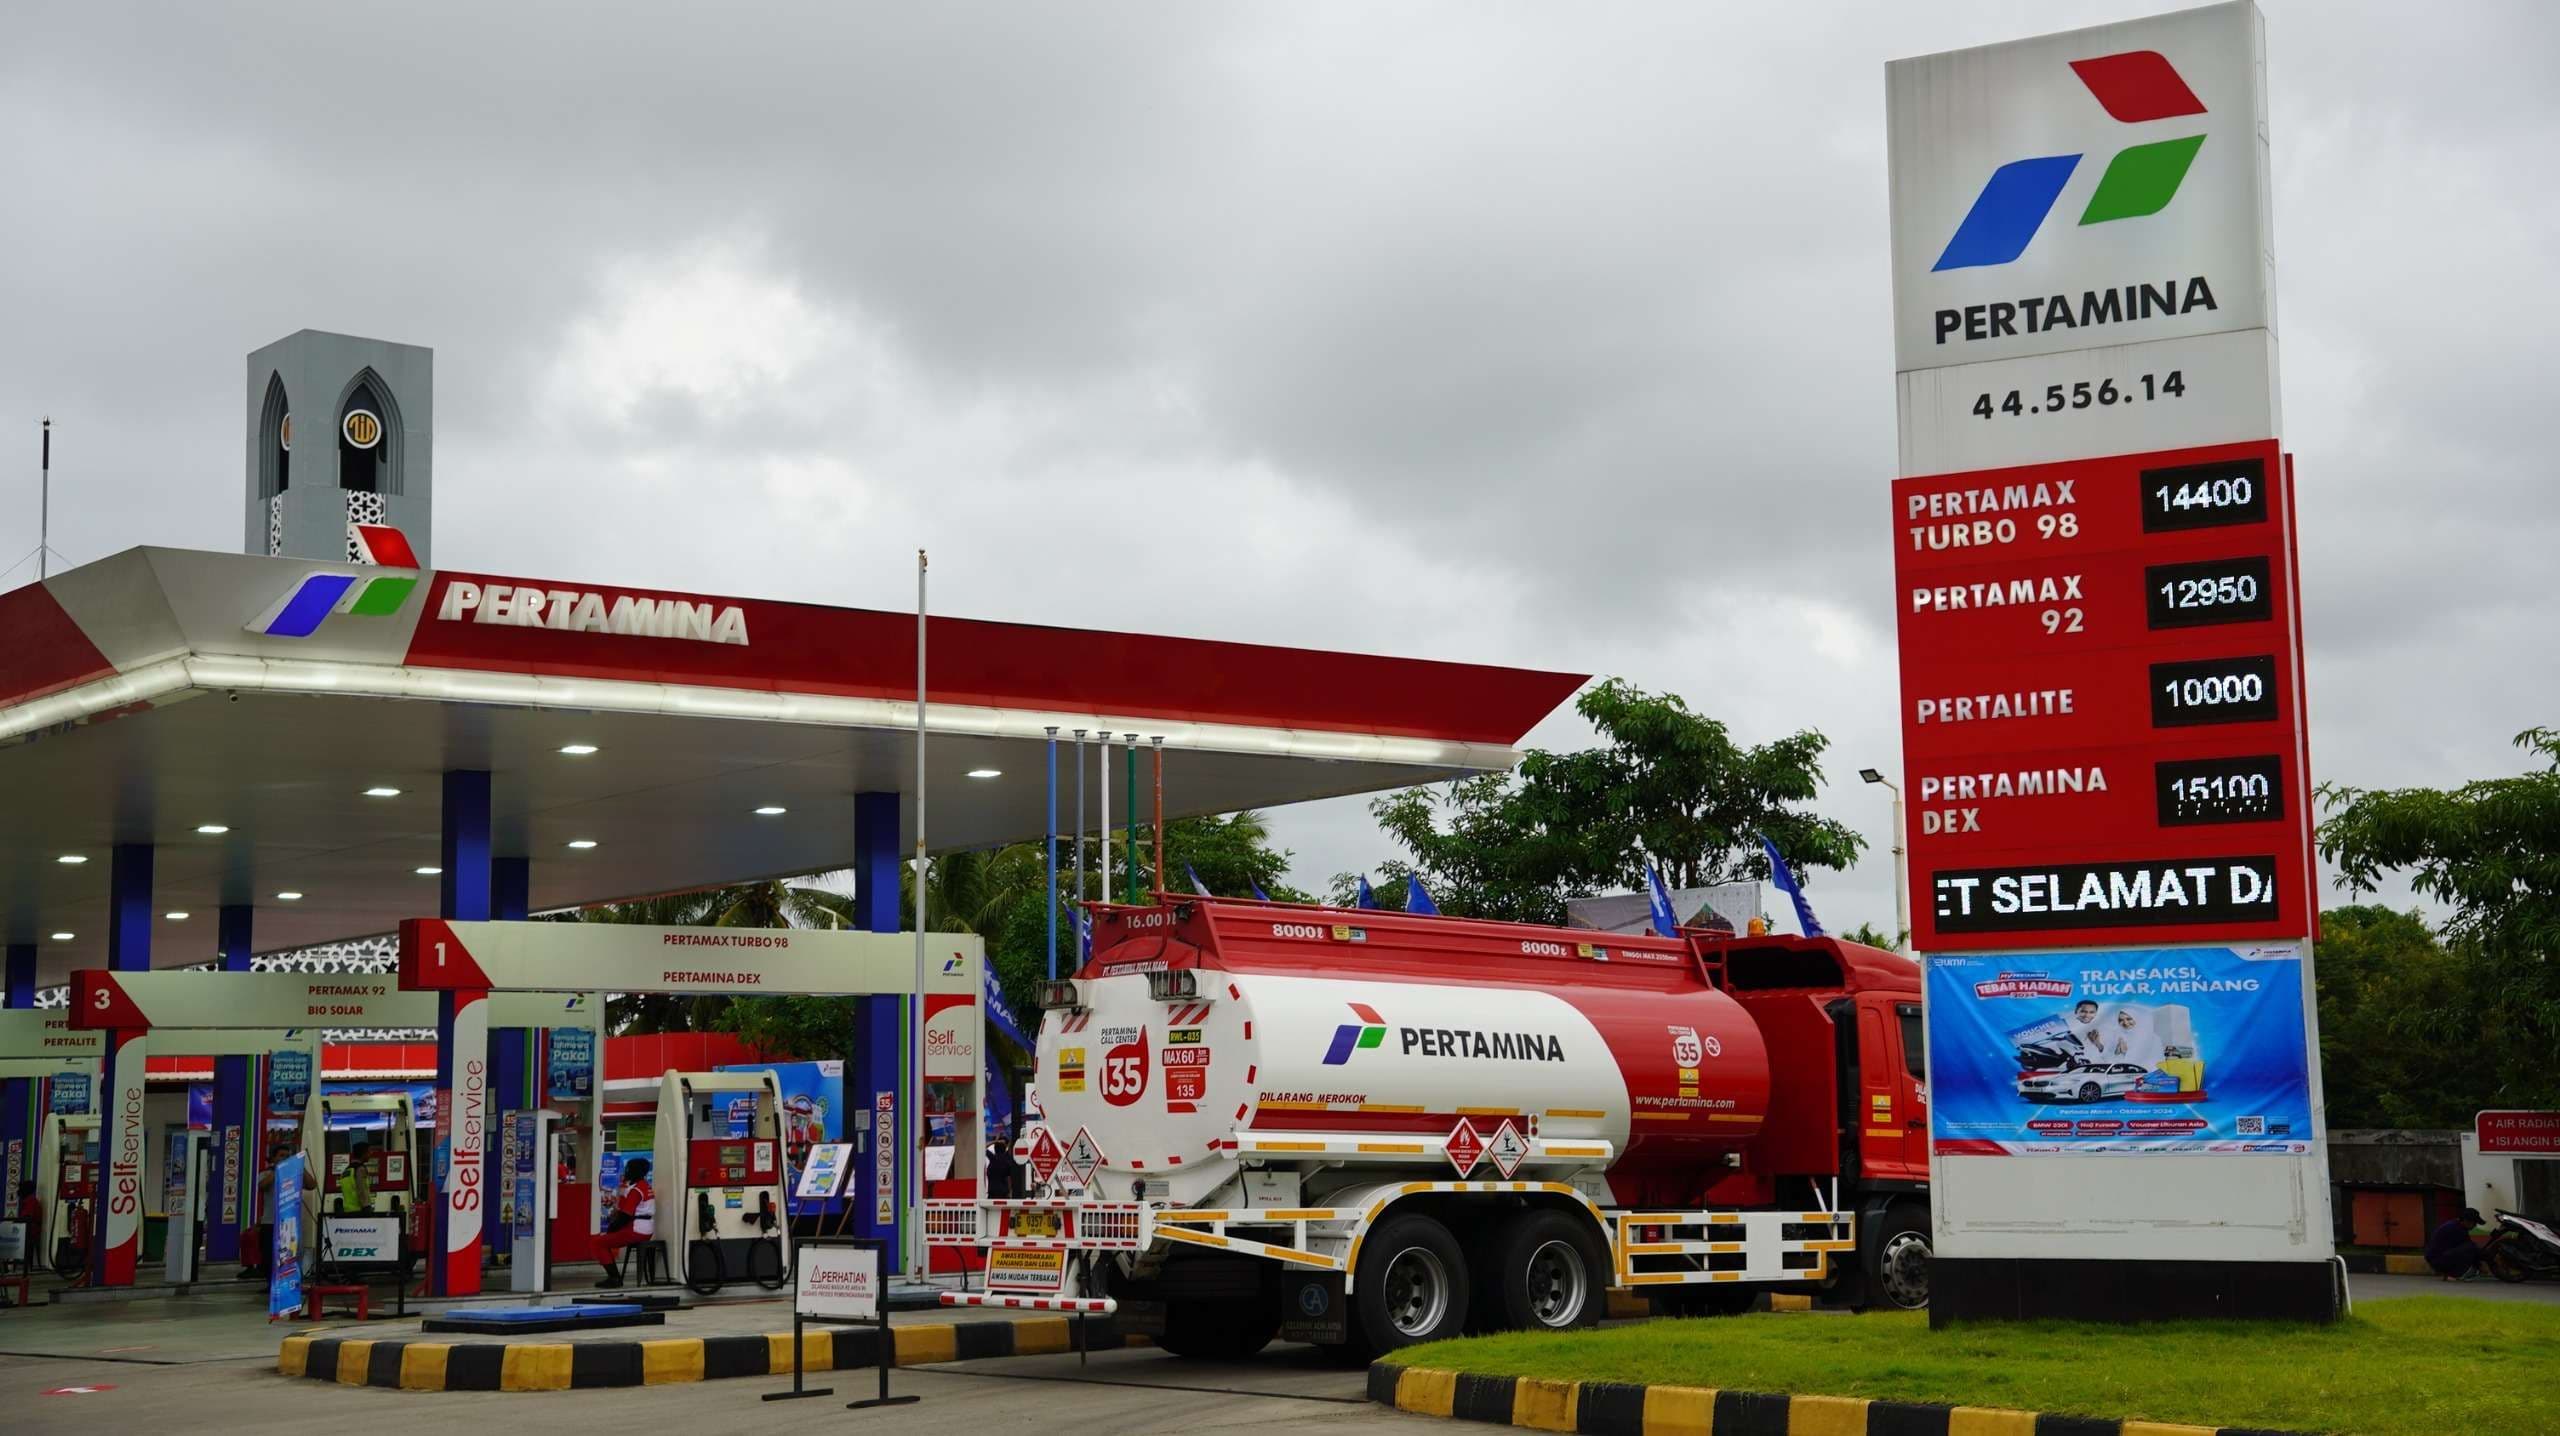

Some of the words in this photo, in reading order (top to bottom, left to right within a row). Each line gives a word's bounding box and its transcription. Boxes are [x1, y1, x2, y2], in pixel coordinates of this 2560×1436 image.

[1935, 276, 2218, 344] PERTAMINA
[1972, 370, 2185, 419] 44.556.14
[1909, 480, 2076, 520] PERTAMAX
[2156, 477, 2251, 512] 14400
[1911, 519, 2016, 551] TURBO
[2037, 513, 2079, 540] 98
[1913, 575, 2083, 613] PERTAMAX
[2161, 575, 2256, 608] 12950
[438, 580, 749, 646] PERTAMINA
[2041, 608, 2084, 634] 92
[2165, 673, 2262, 707] 10000
[1917, 689, 2073, 724] PERTALITE
[1921, 767, 2107, 801] PERTAMINA
[2172, 774, 2268, 815] 15100
[1923, 808, 1980, 834] DEX
[1992, 867, 2215, 913] SELAMAT
[663, 934, 729, 947] PERTAMAX
[731, 935, 772, 948] TURBO
[774, 936, 789, 948] 98
[435, 943, 445, 966] 1
[663, 971, 735, 984] PERTAMINA
[738, 973, 761, 985] DEX
[2080, 967, 2203, 982] TRANSAKSI,
[309, 986, 368, 995] PERTAMAX
[372, 986, 385, 995] 92
[1977, 982, 2016, 994] TEBAR
[2019, 982, 2071, 994] HADIAH
[2080, 982, 2156, 996] TUKAR,
[2161, 979, 2260, 993] MENANG
[94, 989, 110, 1009] 3
[308, 1006, 326, 1015] BIO
[330, 1006, 363, 1015] SOLAR
[1101, 1027, 1138, 1036] PERTAMINA
[1101, 1036, 1114, 1044] CALL
[1115, 1035, 1138, 1044] CENTER
[44, 1038, 96, 1046] PERTALITE
[928, 1044, 972, 1056] service
[1401, 1028, 1565, 1063] PERTAMINA
[553, 1049, 589, 1060] Pakai
[1674, 1043, 1699, 1061] 135
[1102, 1057, 1141, 1095] 135
[1177, 1085, 1195, 1096] 135
[1260, 1092, 1313, 1103] DILARANG
[1317, 1094, 1367, 1104] MEROKOK
[1635, 1095, 1736, 1110] www.pertamina.com
[2496, 1119, 2514, 1128] AIR
[2518, 1119, 2560, 1128] RADIAT
[2496, 1136, 2510, 1146] ISI
[2513, 1136, 2550, 1146] ANGIN
[338, 1248, 378, 1257] DEX
[821, 1272, 867, 1283] PERHATIAN
